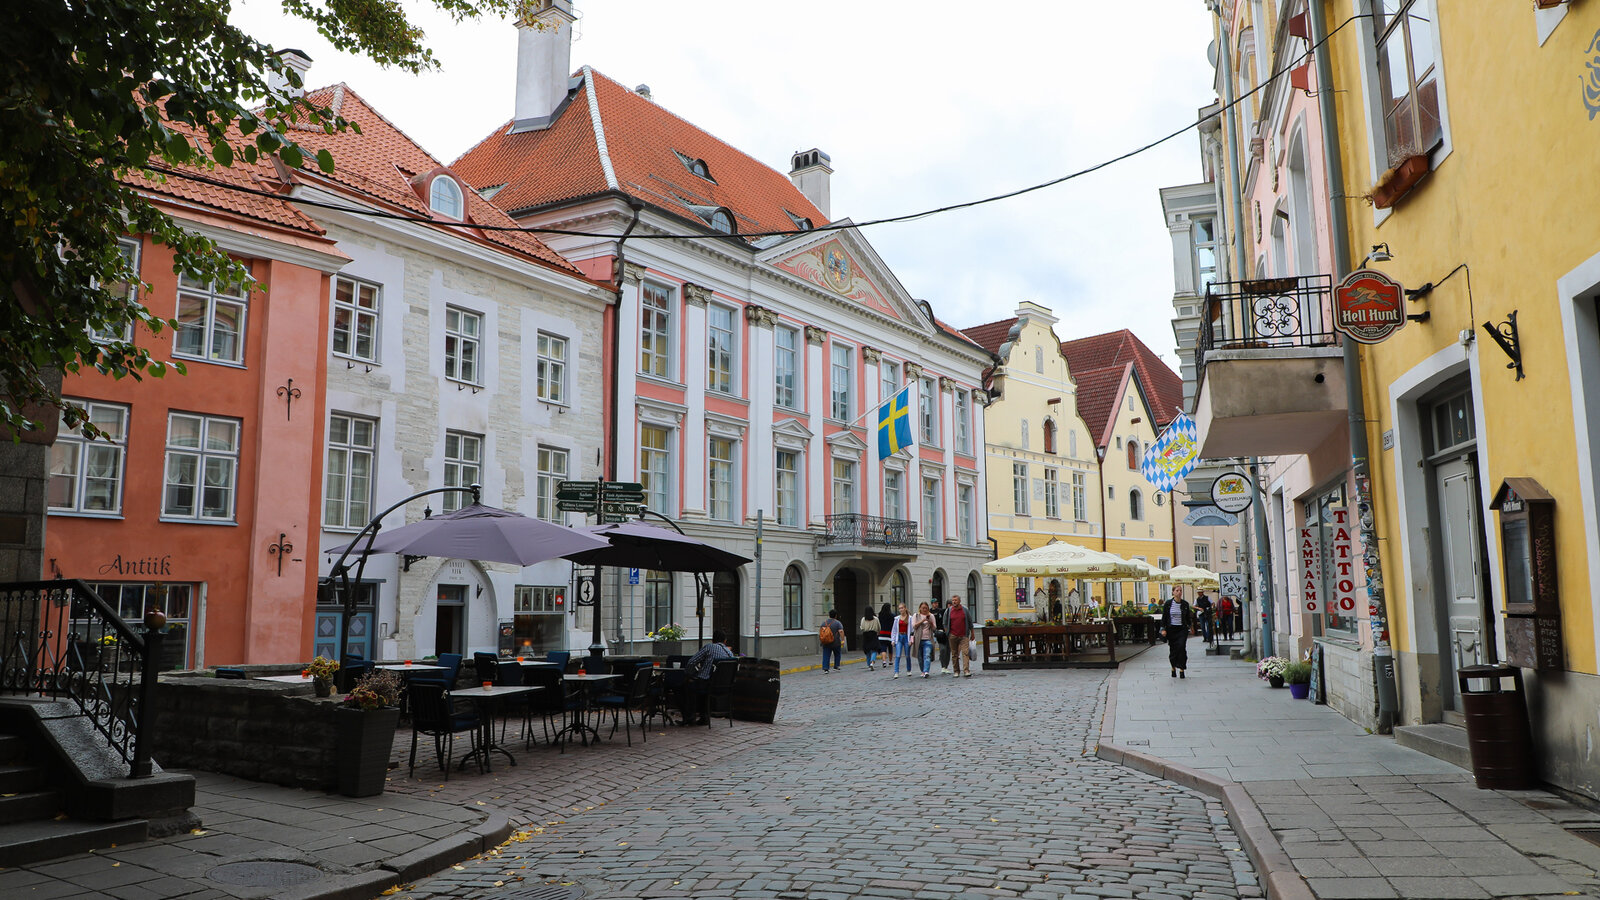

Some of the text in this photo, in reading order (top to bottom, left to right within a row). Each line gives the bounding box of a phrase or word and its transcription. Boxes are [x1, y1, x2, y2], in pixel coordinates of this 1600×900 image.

[1342, 308, 1399, 322] Hell Hunt
[98, 554, 172, 576] Antiik
[1301, 528, 1317, 611] KAMPAAMO
[1333, 510, 1355, 611] TATTOO
[631, 568, 638, 576] P
